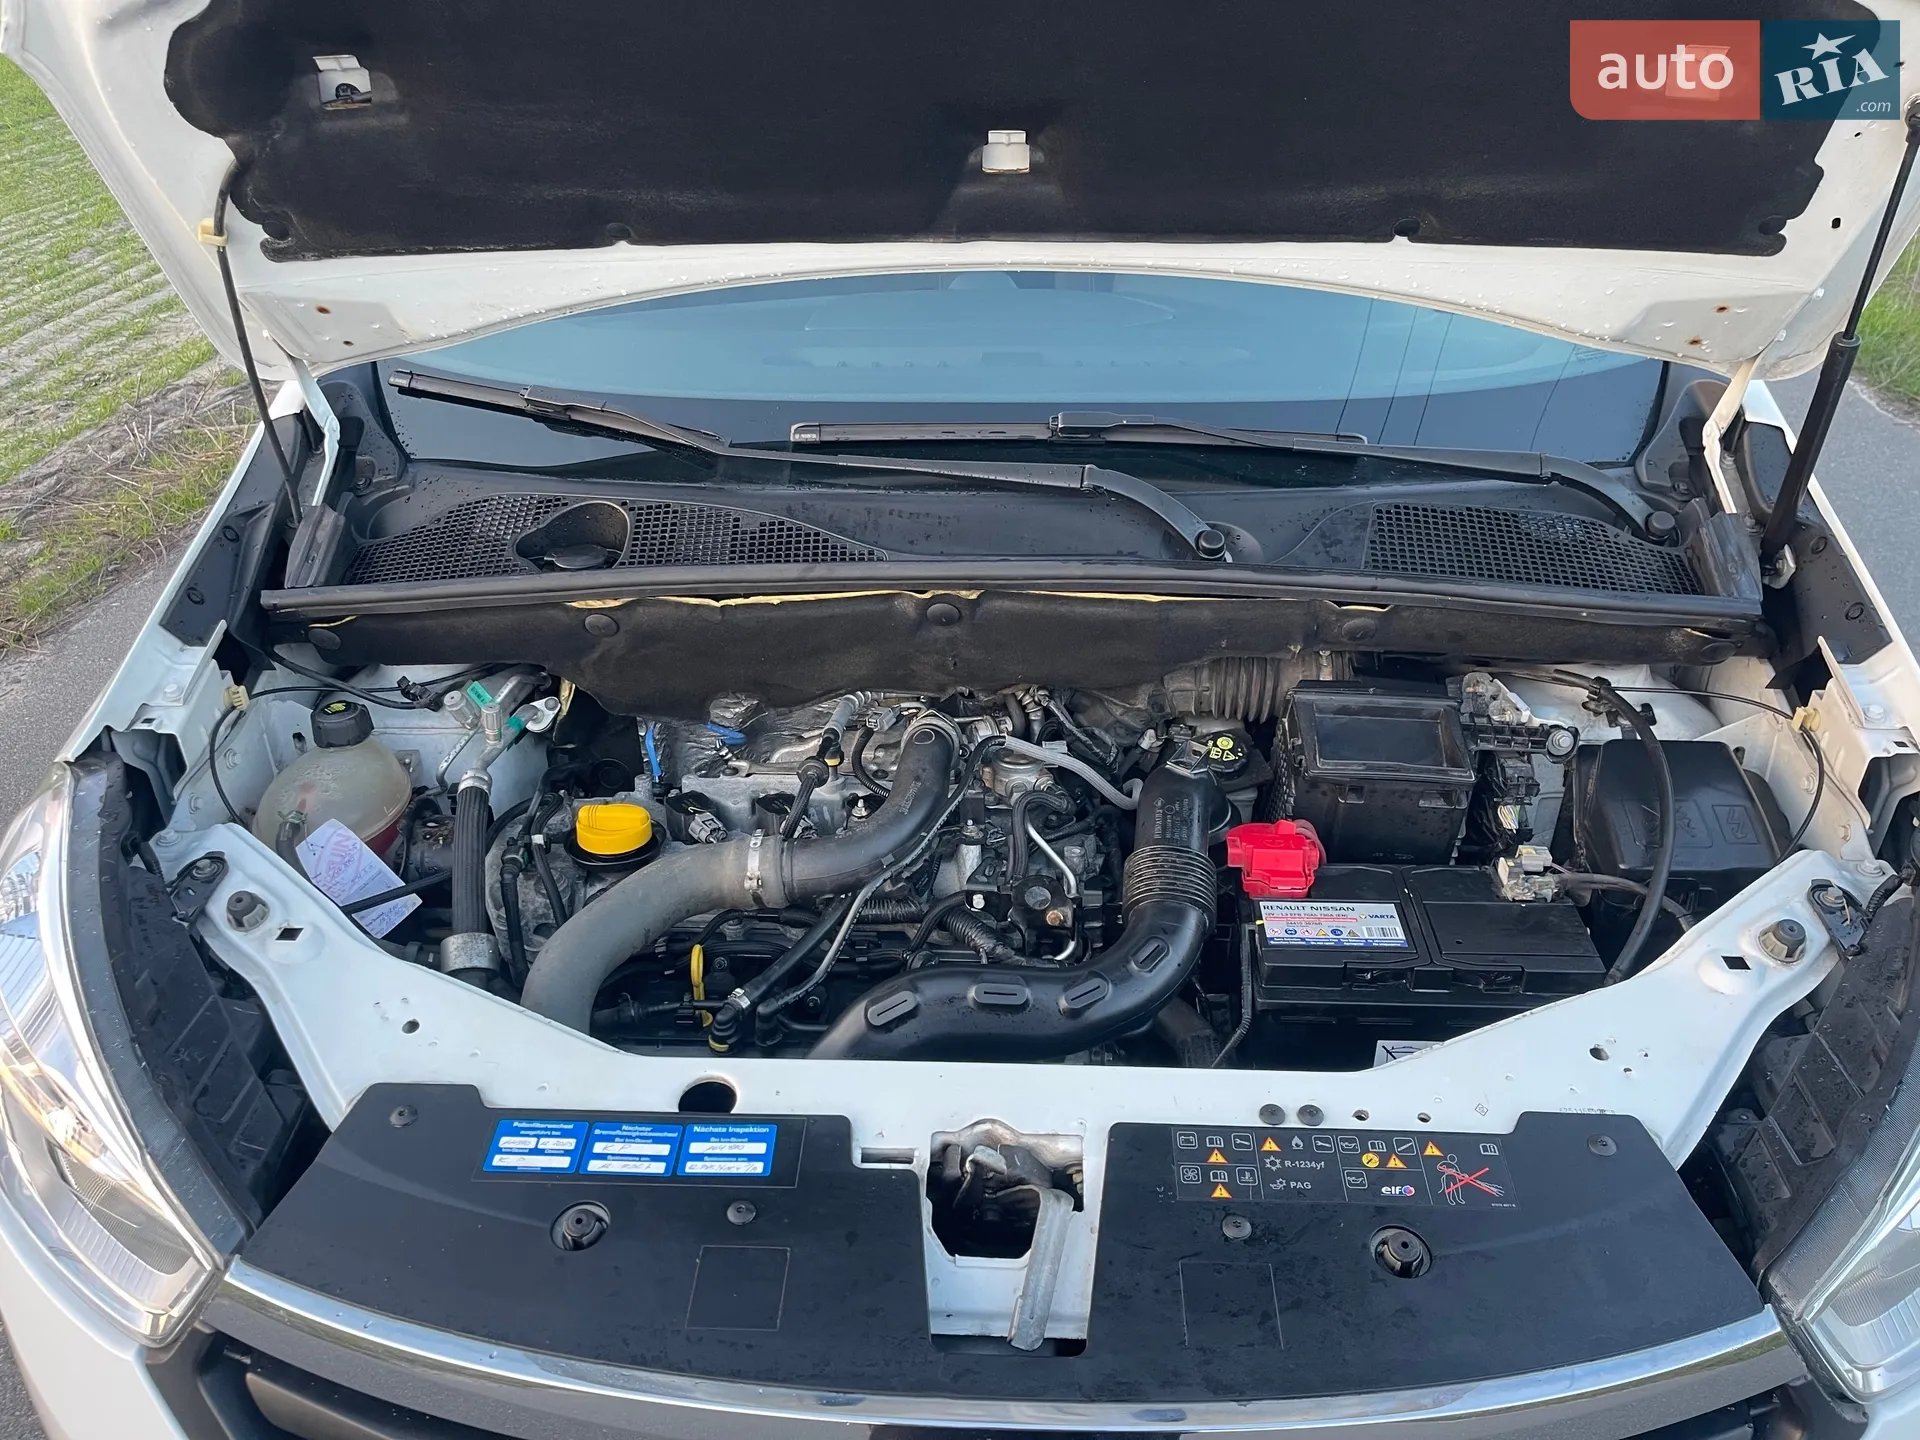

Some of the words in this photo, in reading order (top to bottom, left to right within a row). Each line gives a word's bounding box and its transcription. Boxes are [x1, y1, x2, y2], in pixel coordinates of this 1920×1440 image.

[728, 1126, 769, 1134] Inspektion
[1284, 1160, 1325, 1170] R-1234yf
[1290, 1180, 1312, 1190] PAG
[1381, 1185, 1403, 1196] elf
